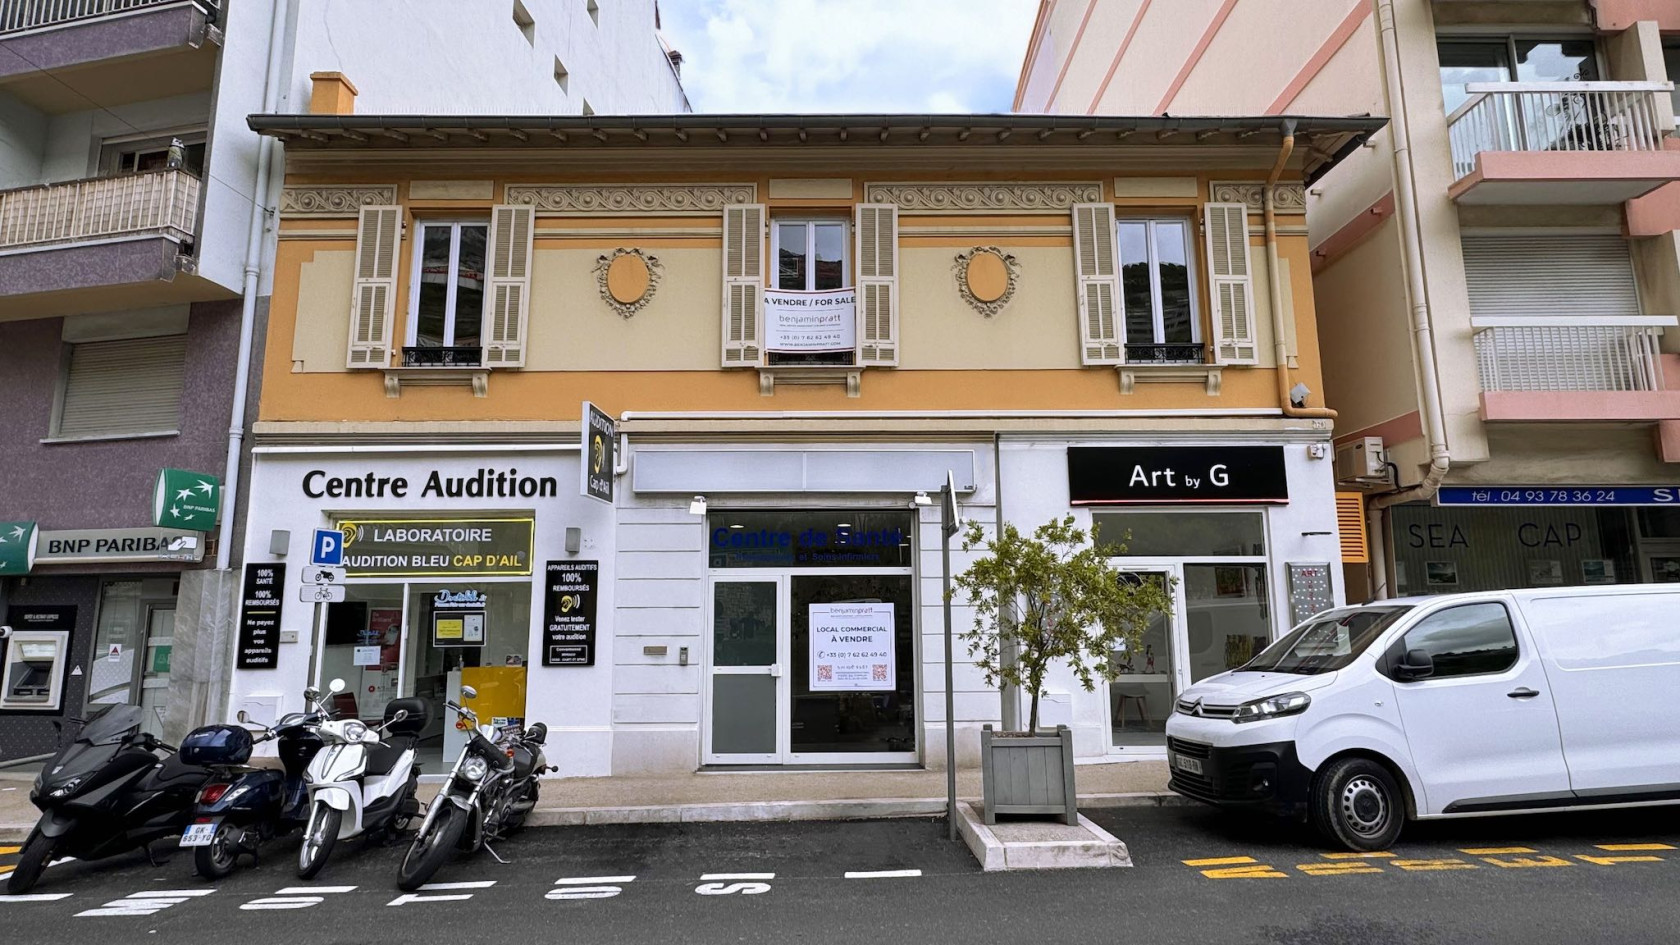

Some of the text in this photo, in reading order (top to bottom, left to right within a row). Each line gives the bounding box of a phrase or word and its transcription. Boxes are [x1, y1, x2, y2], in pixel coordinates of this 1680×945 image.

[771, 298, 807, 306] VENDRE
[809, 298, 813, 307] /
[815, 298, 833, 306] FOR
[835, 296, 856, 305] SALE
[779, 314, 841, 323] benjaminpratt
[589, 411, 614, 437] AUDITION
[1129, 463, 1229, 489] Art by G
[302, 468, 557, 499] Centre Audition
[589, 475, 599, 493] Cap
[1500, 490, 1520, 502] 04
[1526, 490, 1545, 502] 93
[1549, 490, 1568, 502] 78
[1572, 490, 1592, 502] 36
[1596, 490, 1616, 502] 24
[373, 527, 492, 542] LABORATOIRE
[712, 525, 901, 548] Centre de Santé
[1408, 522, 1582, 548] SEA CAP
[48, 538, 90, 554] BNP
[320, 536, 336, 559] P
[341, 554, 522, 567] AUDITION BLEU CAP D'AIL
[257, 569, 274, 577] 100%
[561, 572, 582, 582] 100%
[255, 577, 273, 585] SANTÉ
[552, 584, 590, 592] REMBOURSÉS
[255, 590, 272, 598] 100%
[244, 598, 280, 606] REMBOURSÉS
[830, 606, 873, 614] benjaminpratt
[256, 620, 275, 628] payez
[549, 624, 590, 632] GRATUITEMENT
[252, 628, 267, 636] plus
[831, 635, 873, 643] À VENDRE
[244, 647, 272, 655] appareils
